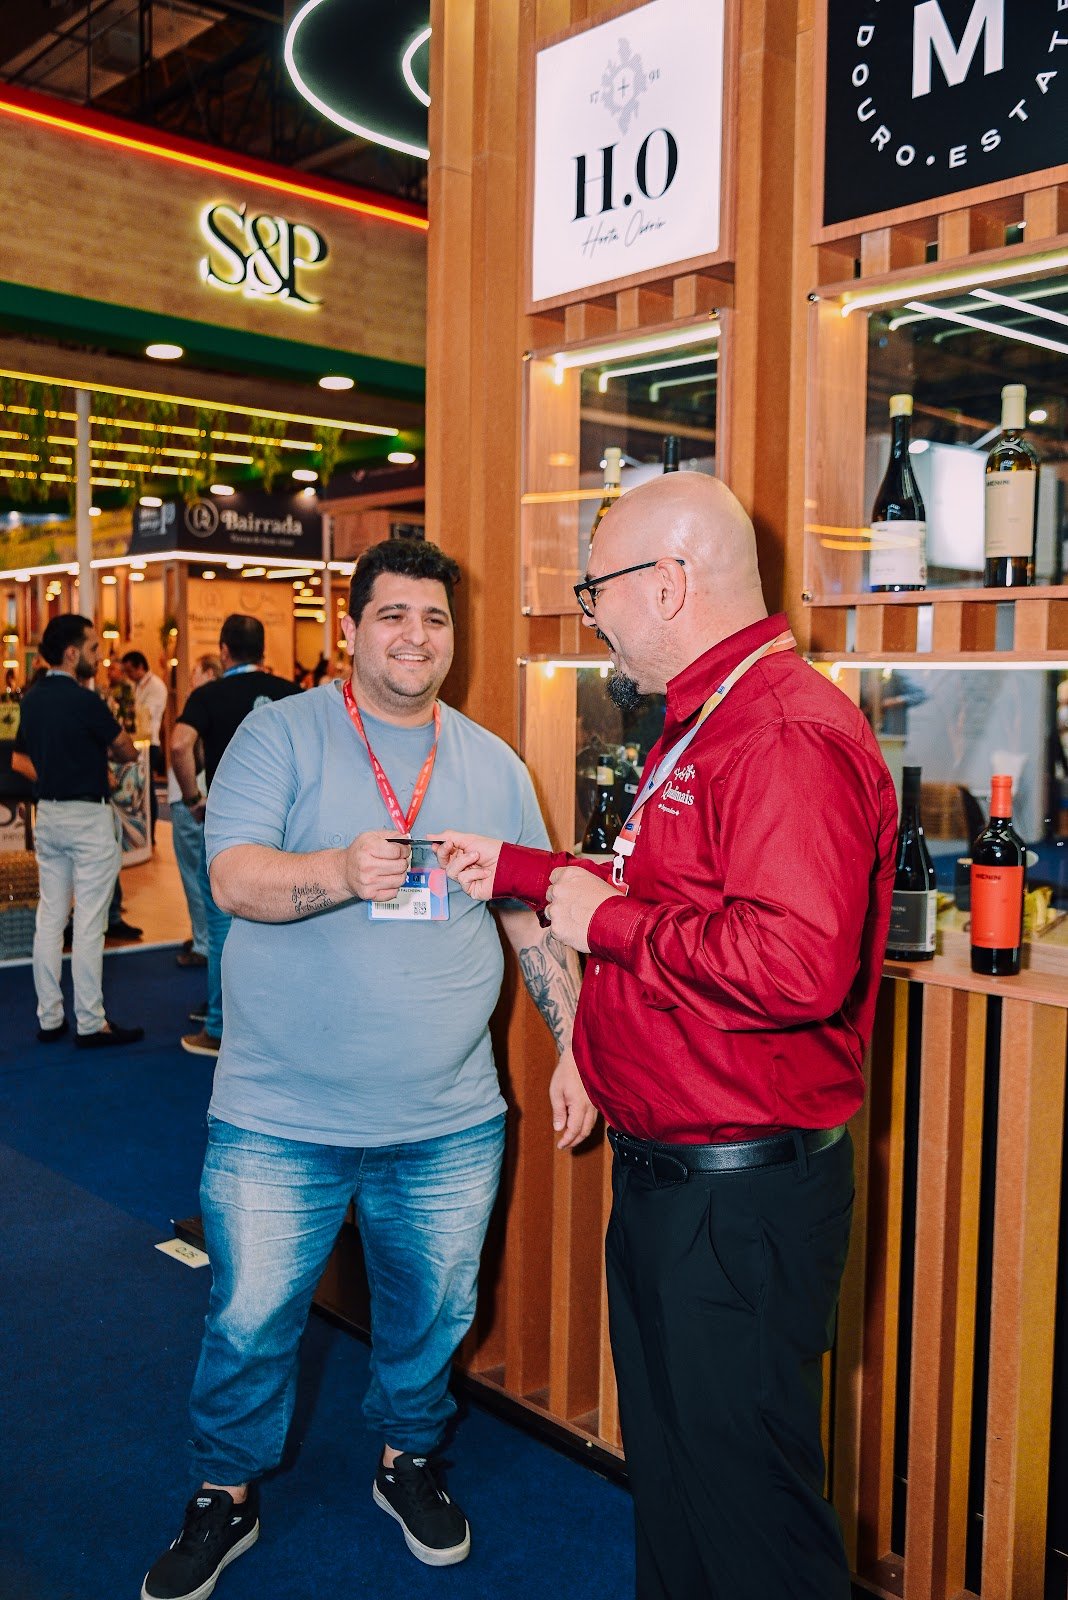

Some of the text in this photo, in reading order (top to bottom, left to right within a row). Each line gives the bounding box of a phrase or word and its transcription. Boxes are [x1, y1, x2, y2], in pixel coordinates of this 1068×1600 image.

[851, 25, 916, 167] DOURO
[912, 0, 1005, 100] M
[200, 202, 328, 309] S&P
[220, 509, 303, 536] Bairrada
